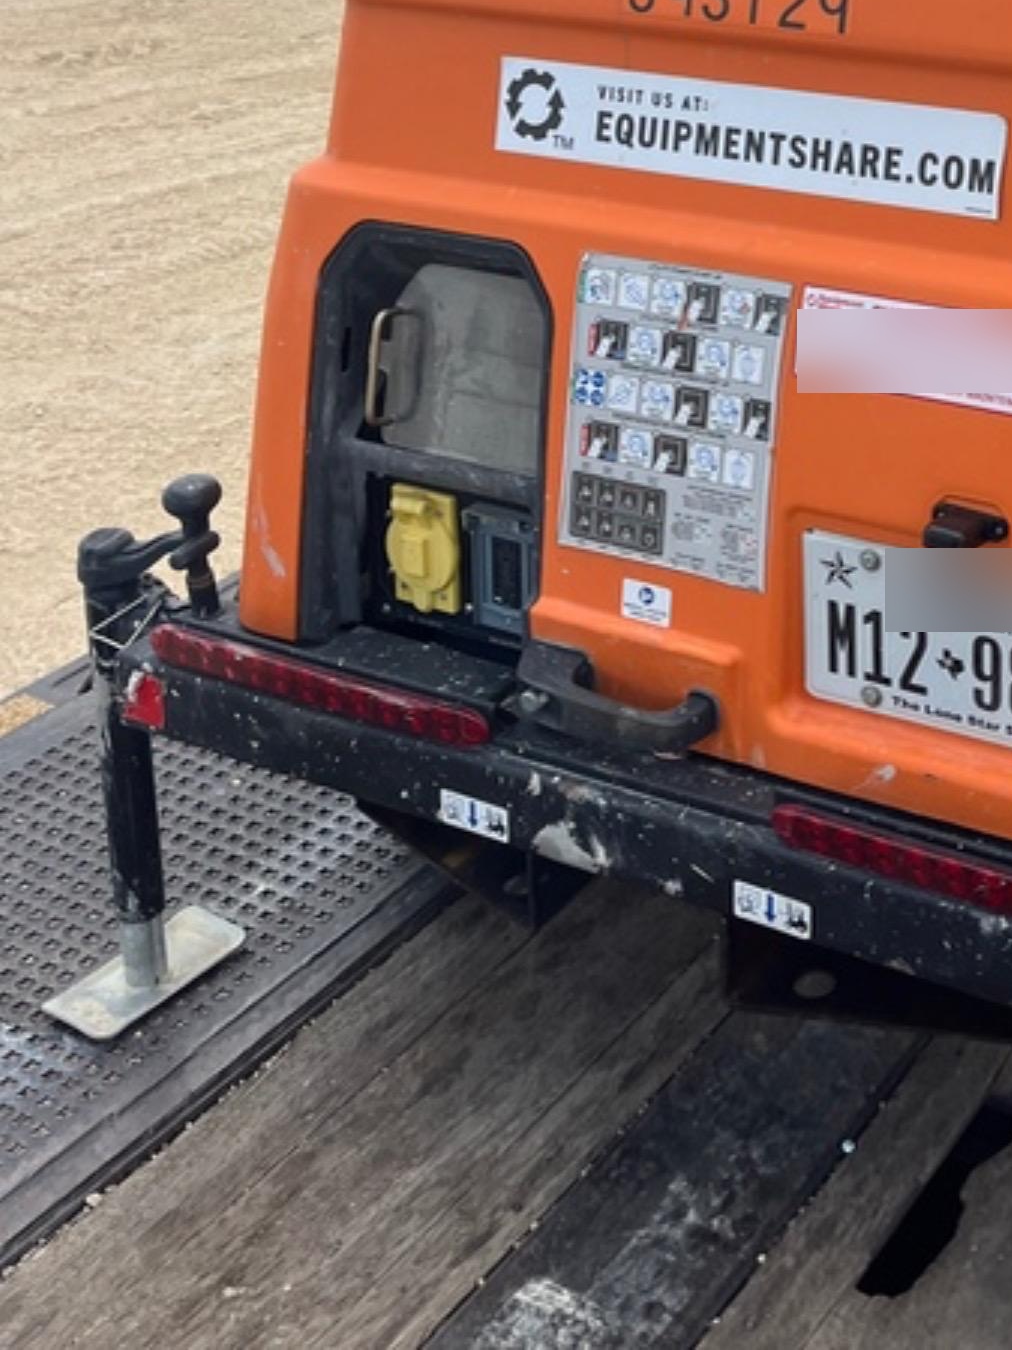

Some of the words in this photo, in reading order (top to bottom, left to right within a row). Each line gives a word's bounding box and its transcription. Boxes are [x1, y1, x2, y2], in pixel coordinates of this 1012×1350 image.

[597, 85, 644, 105] VISIT
[651, 92, 673, 109] US
[680, 95, 709, 112] AT:
[553, 135, 574, 150] TM
[595, 109, 996, 195] EQUIPMENTSHARE.COM
[891, 695, 920, 712] The
[923, 703, 963, 723] Lone
[967, 714, 1000, 732] Star
